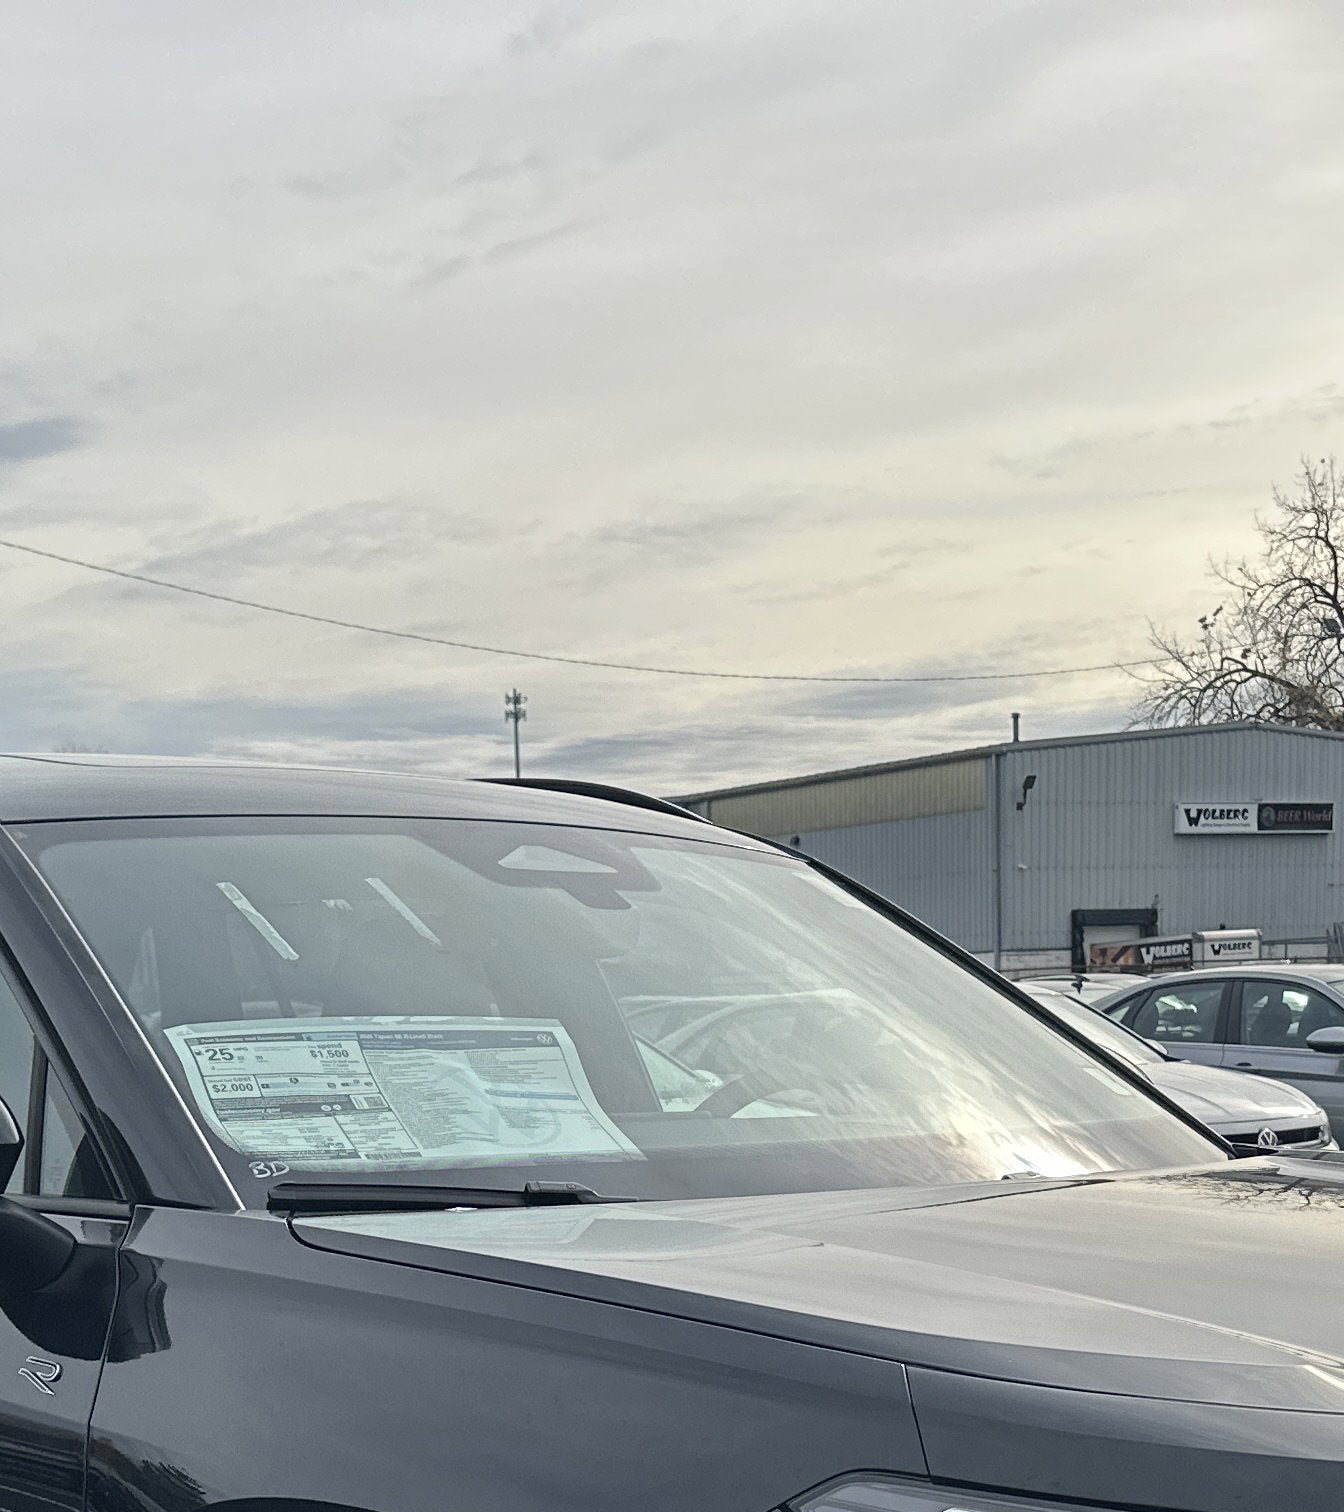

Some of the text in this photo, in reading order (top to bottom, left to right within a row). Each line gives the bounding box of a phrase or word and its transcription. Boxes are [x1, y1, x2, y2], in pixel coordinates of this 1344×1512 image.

[205, 1048, 234, 1061] 25
[310, 1049, 349, 1059] $1,500
[212, 1083, 253, 1093] $2,000
